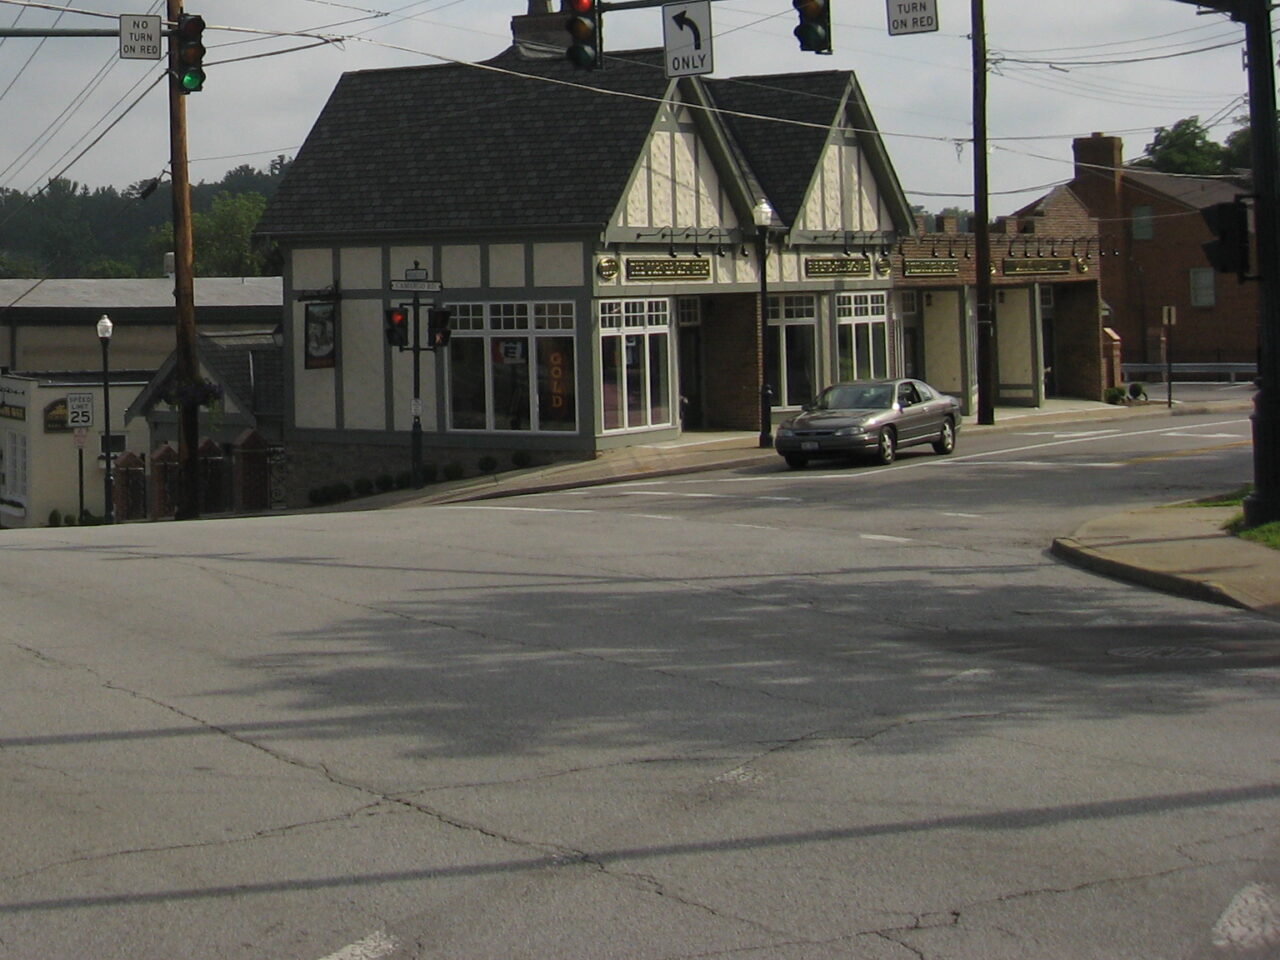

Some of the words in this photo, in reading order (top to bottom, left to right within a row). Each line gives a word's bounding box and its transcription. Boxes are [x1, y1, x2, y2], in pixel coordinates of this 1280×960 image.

[897, 1, 927, 14] TURN
[132, 20, 149, 30] NO
[892, 19, 908, 30] ON
[911, 15, 934, 28] RED
[129, 32, 153, 42] TURN
[123, 44, 136, 54] ON
[140, 45, 158, 54] RED
[672, 53, 706, 71] ONLY
[549, 352, 564, 408] GOLD
[70, 395, 91, 403] SPEED
[70, 410, 90, 423] 25
